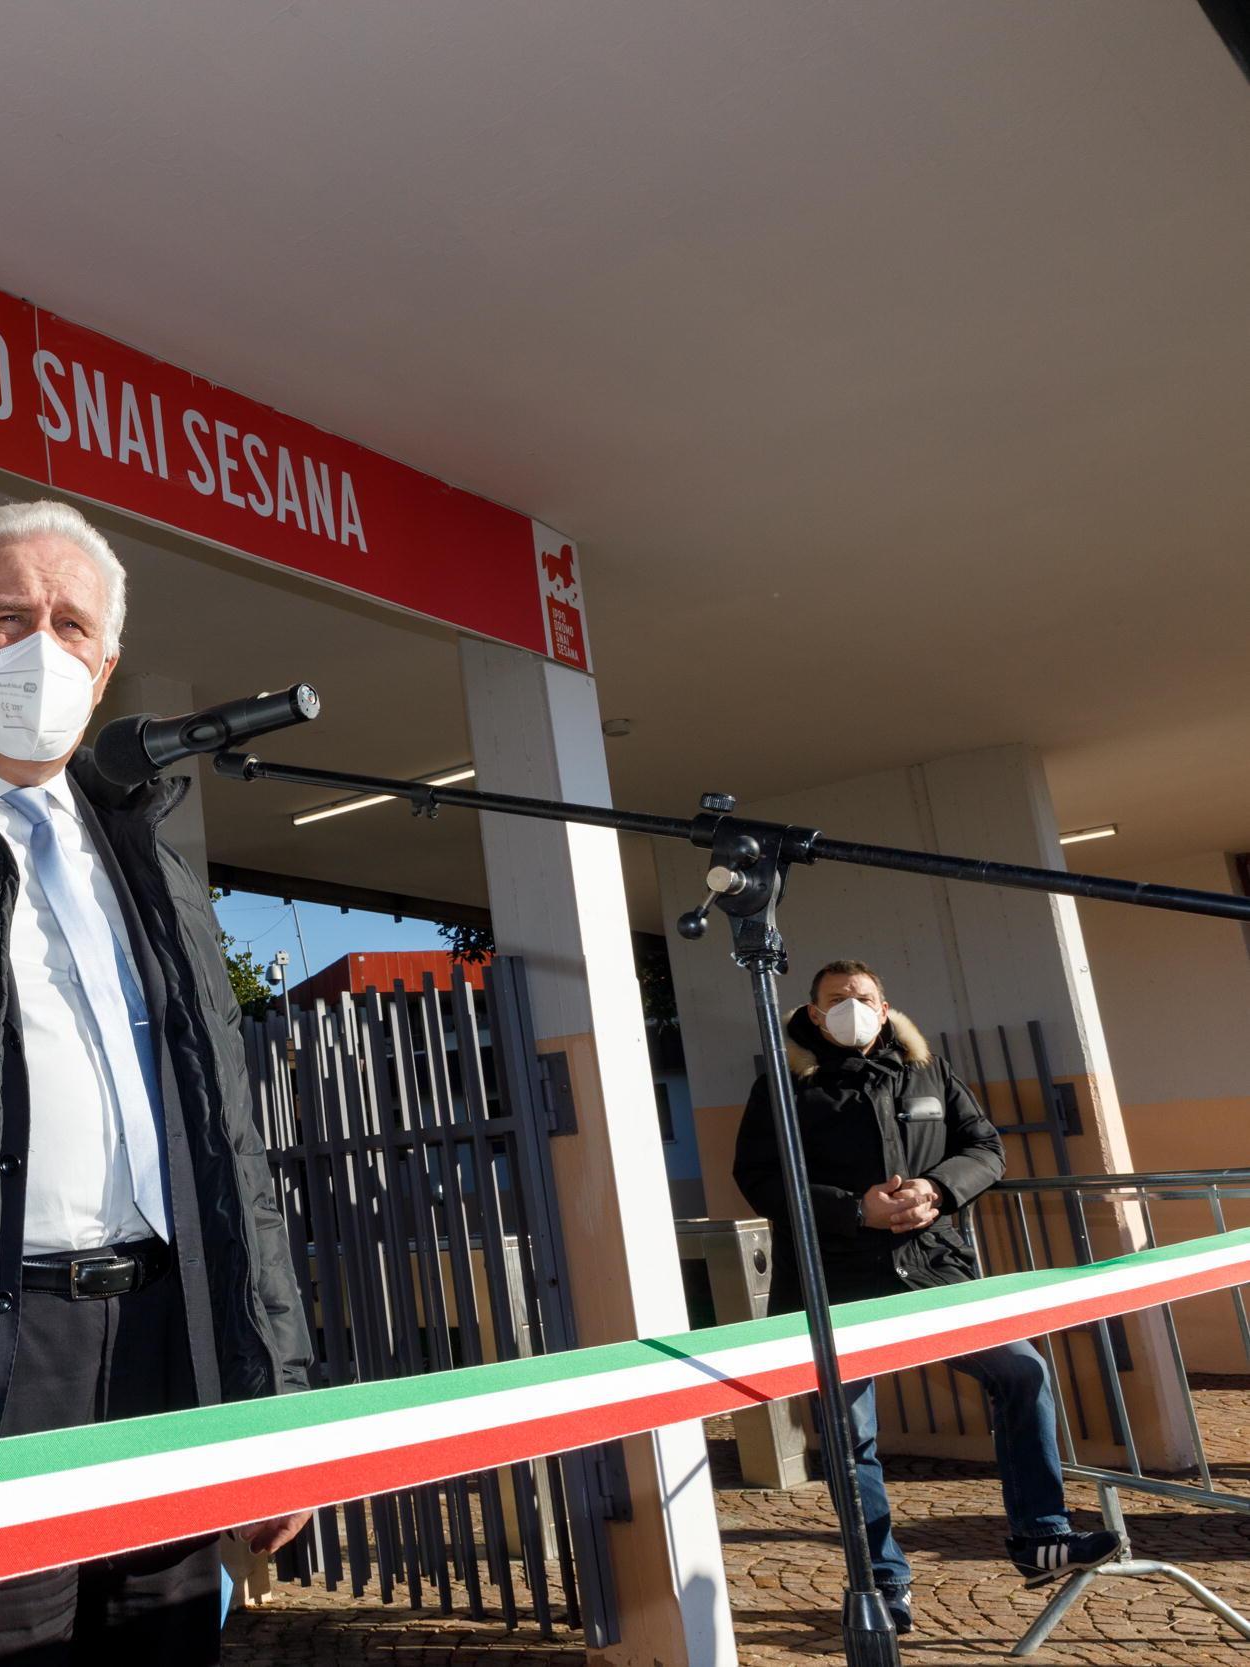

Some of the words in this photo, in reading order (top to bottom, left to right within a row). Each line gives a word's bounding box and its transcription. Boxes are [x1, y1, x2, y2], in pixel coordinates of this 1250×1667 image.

[32, 350, 169, 480] SNAI
[182, 409, 368, 553] SESANA
[552, 607, 566, 623] IPPO
[553, 619, 574, 637] DROMO
[555, 631, 569, 646] SNAI
[557, 643, 580, 662] SESANA
